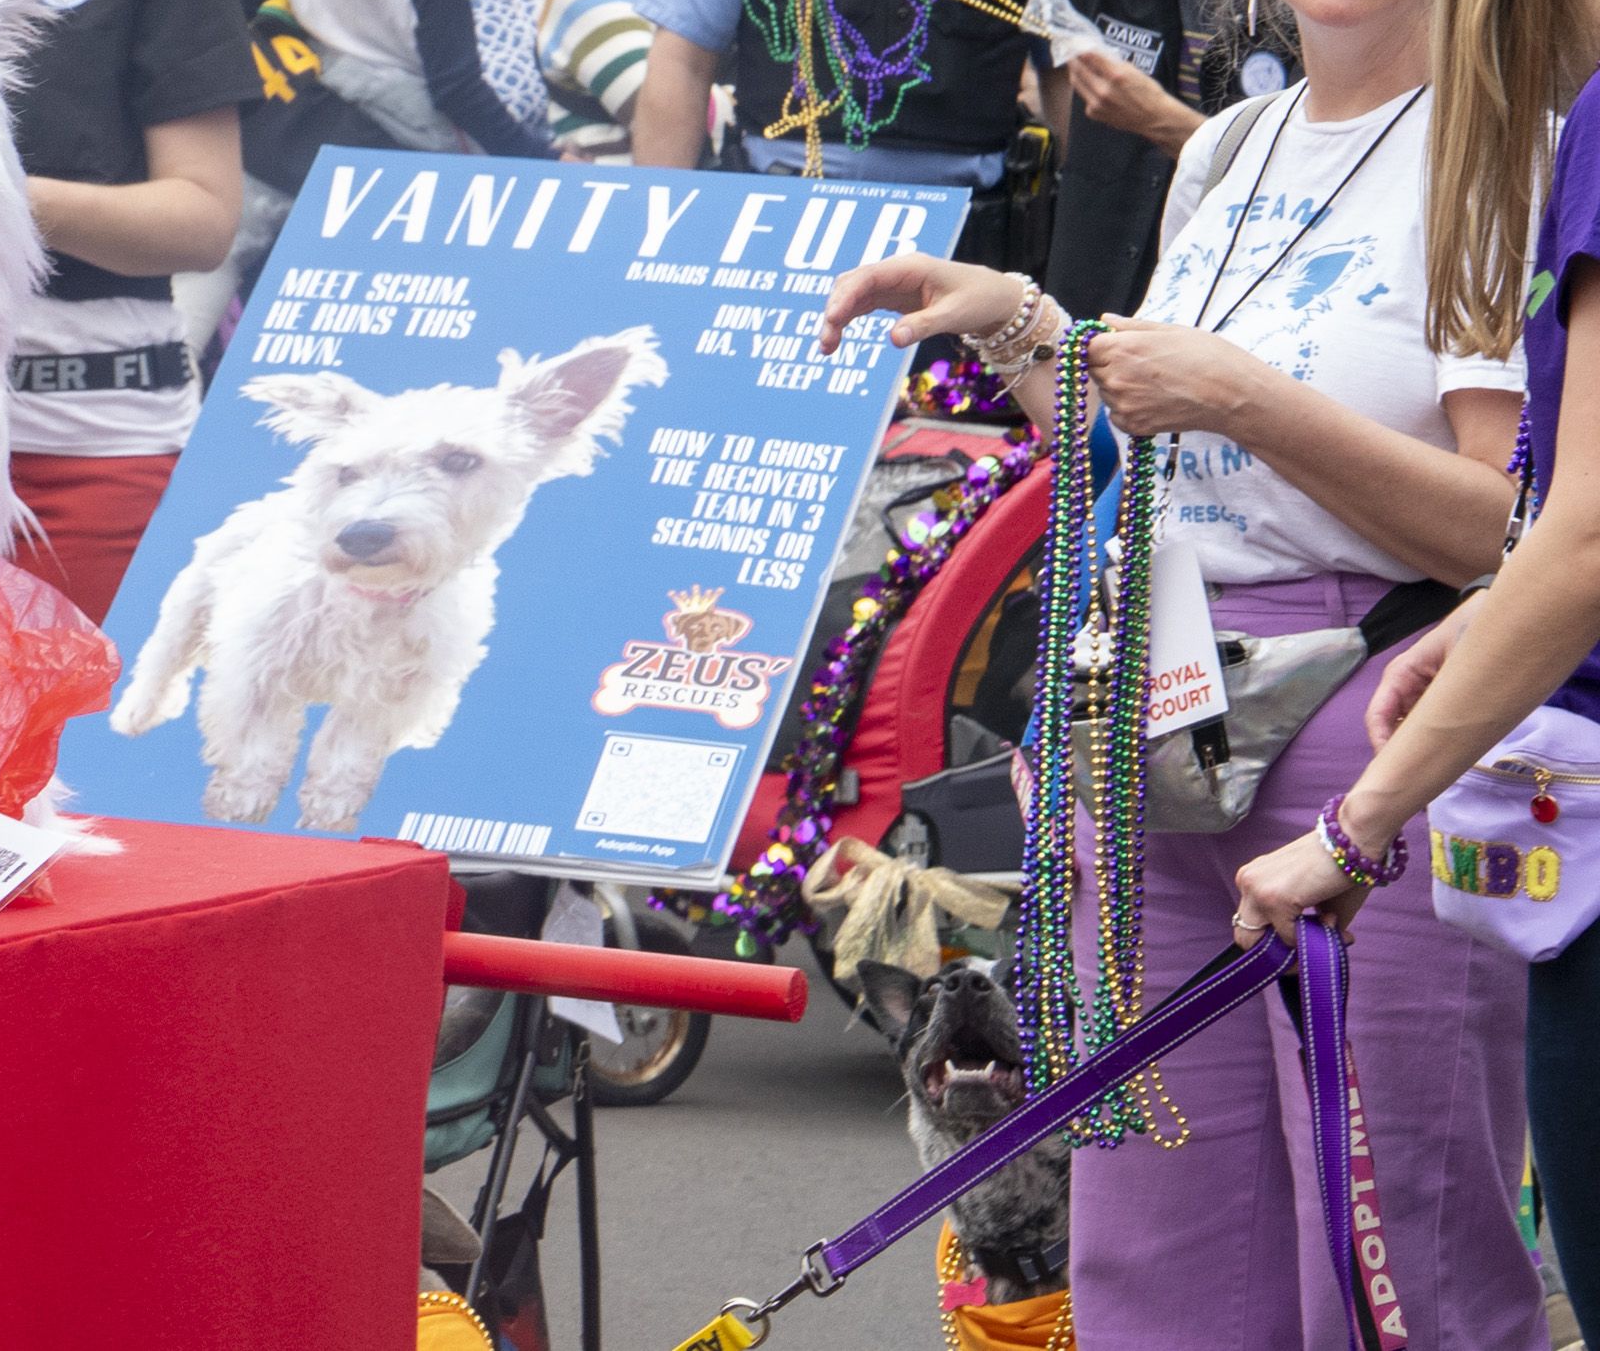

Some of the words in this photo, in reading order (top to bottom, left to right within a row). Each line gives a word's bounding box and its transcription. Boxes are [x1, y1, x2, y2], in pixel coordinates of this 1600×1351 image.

[1106, 24, 1152, 49] DAVID
[812, 183, 889, 198] FEBRUARY
[320, 166, 700, 258] VANITY
[720, 193, 928, 271] FUR
[1226, 193, 1333, 230] TEAM
[278, 268, 363, 300] MEET
[366, 272, 471, 307] SCRIM.
[625, 261, 710, 286] BARKUS
[711, 267, 778, 291] RULES
[263, 301, 309, 331] HE
[310, 303, 398, 336] RUNS
[404, 307, 478, 340] THIS
[713, 304, 793, 333] DON'T
[795, 311, 896, 342] CSE?
[251, 334, 344, 367] TOWN.
[695, 330, 737, 356] HA.
[750, 333, 803, 361] YOU
[806, 339, 887, 368] CAN'T
[756, 361, 824, 390] KEEP
[827, 367, 870, 396] UP.
[649, 427, 716, 458] HOW
[719, 434, 755, 463] TO
[758, 438, 848, 473] GHOST
[651, 457, 701, 487] THE
[702, 462, 838, 502] RECOVERY
[691, 491, 764, 524] TEAM
[766, 499, 799, 528] IN
[802, 504, 826, 532] 3
[652, 517, 771, 556] SECONDS
[774, 531, 815, 561] OR
[737, 557, 805, 590] LESS
[621, 645, 792, 692] ZEUS'
[1147, 661, 1207, 694] ROYAL
[622, 682, 743, 709] RESCUES
[1149, 684, 1211, 721] COURT
[1350, 1176, 1408, 1339] ADOPT
